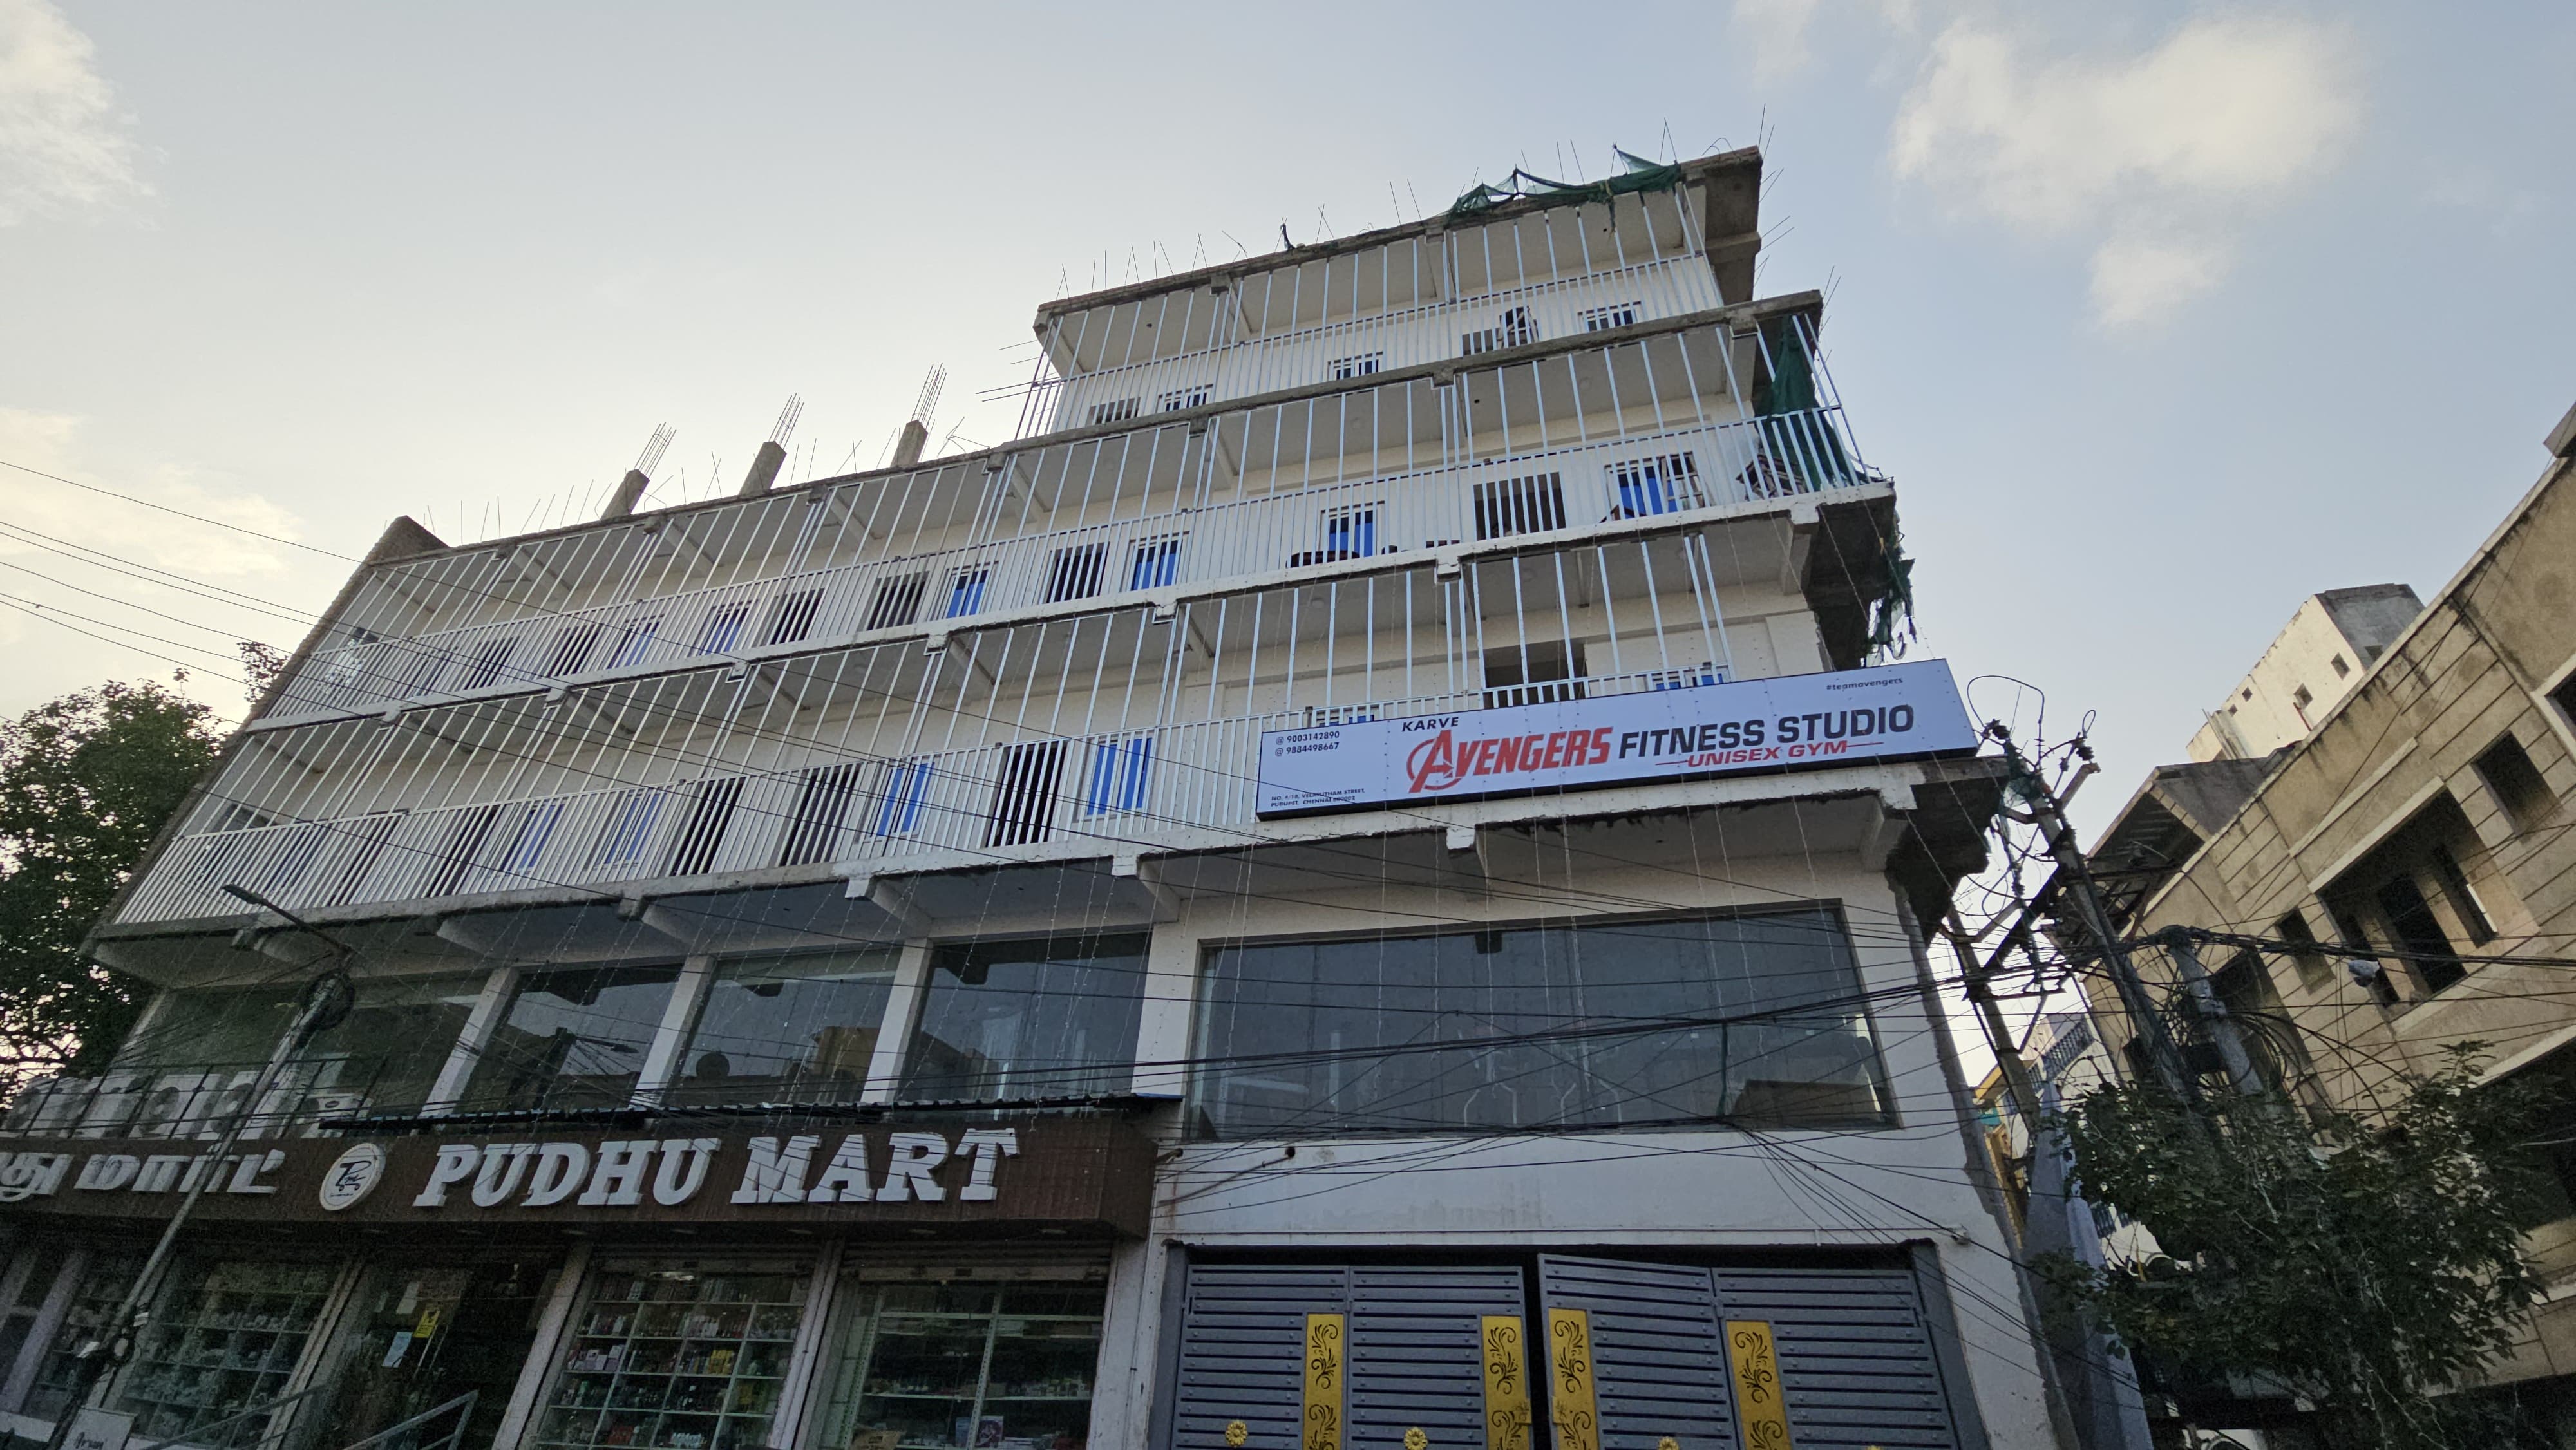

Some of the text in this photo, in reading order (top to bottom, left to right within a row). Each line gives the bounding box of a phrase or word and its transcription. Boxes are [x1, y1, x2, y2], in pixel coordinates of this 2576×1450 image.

[1826, 678, 1903, 691] #teamavengers
[1402, 717, 1459, 732] KARVE
[1287, 731, 1340, 743] 9003142890
[1286, 742, 1340, 755] 9884498667
[1406, 704, 1915, 793] AVENGERS FITNESS STUDIO
[1687, 740, 1848, 767] UNISEX GYM
[1303, 796, 1331, 805] CHENNAI
[413, 1127, 1019, 1207] PUDHU MART
